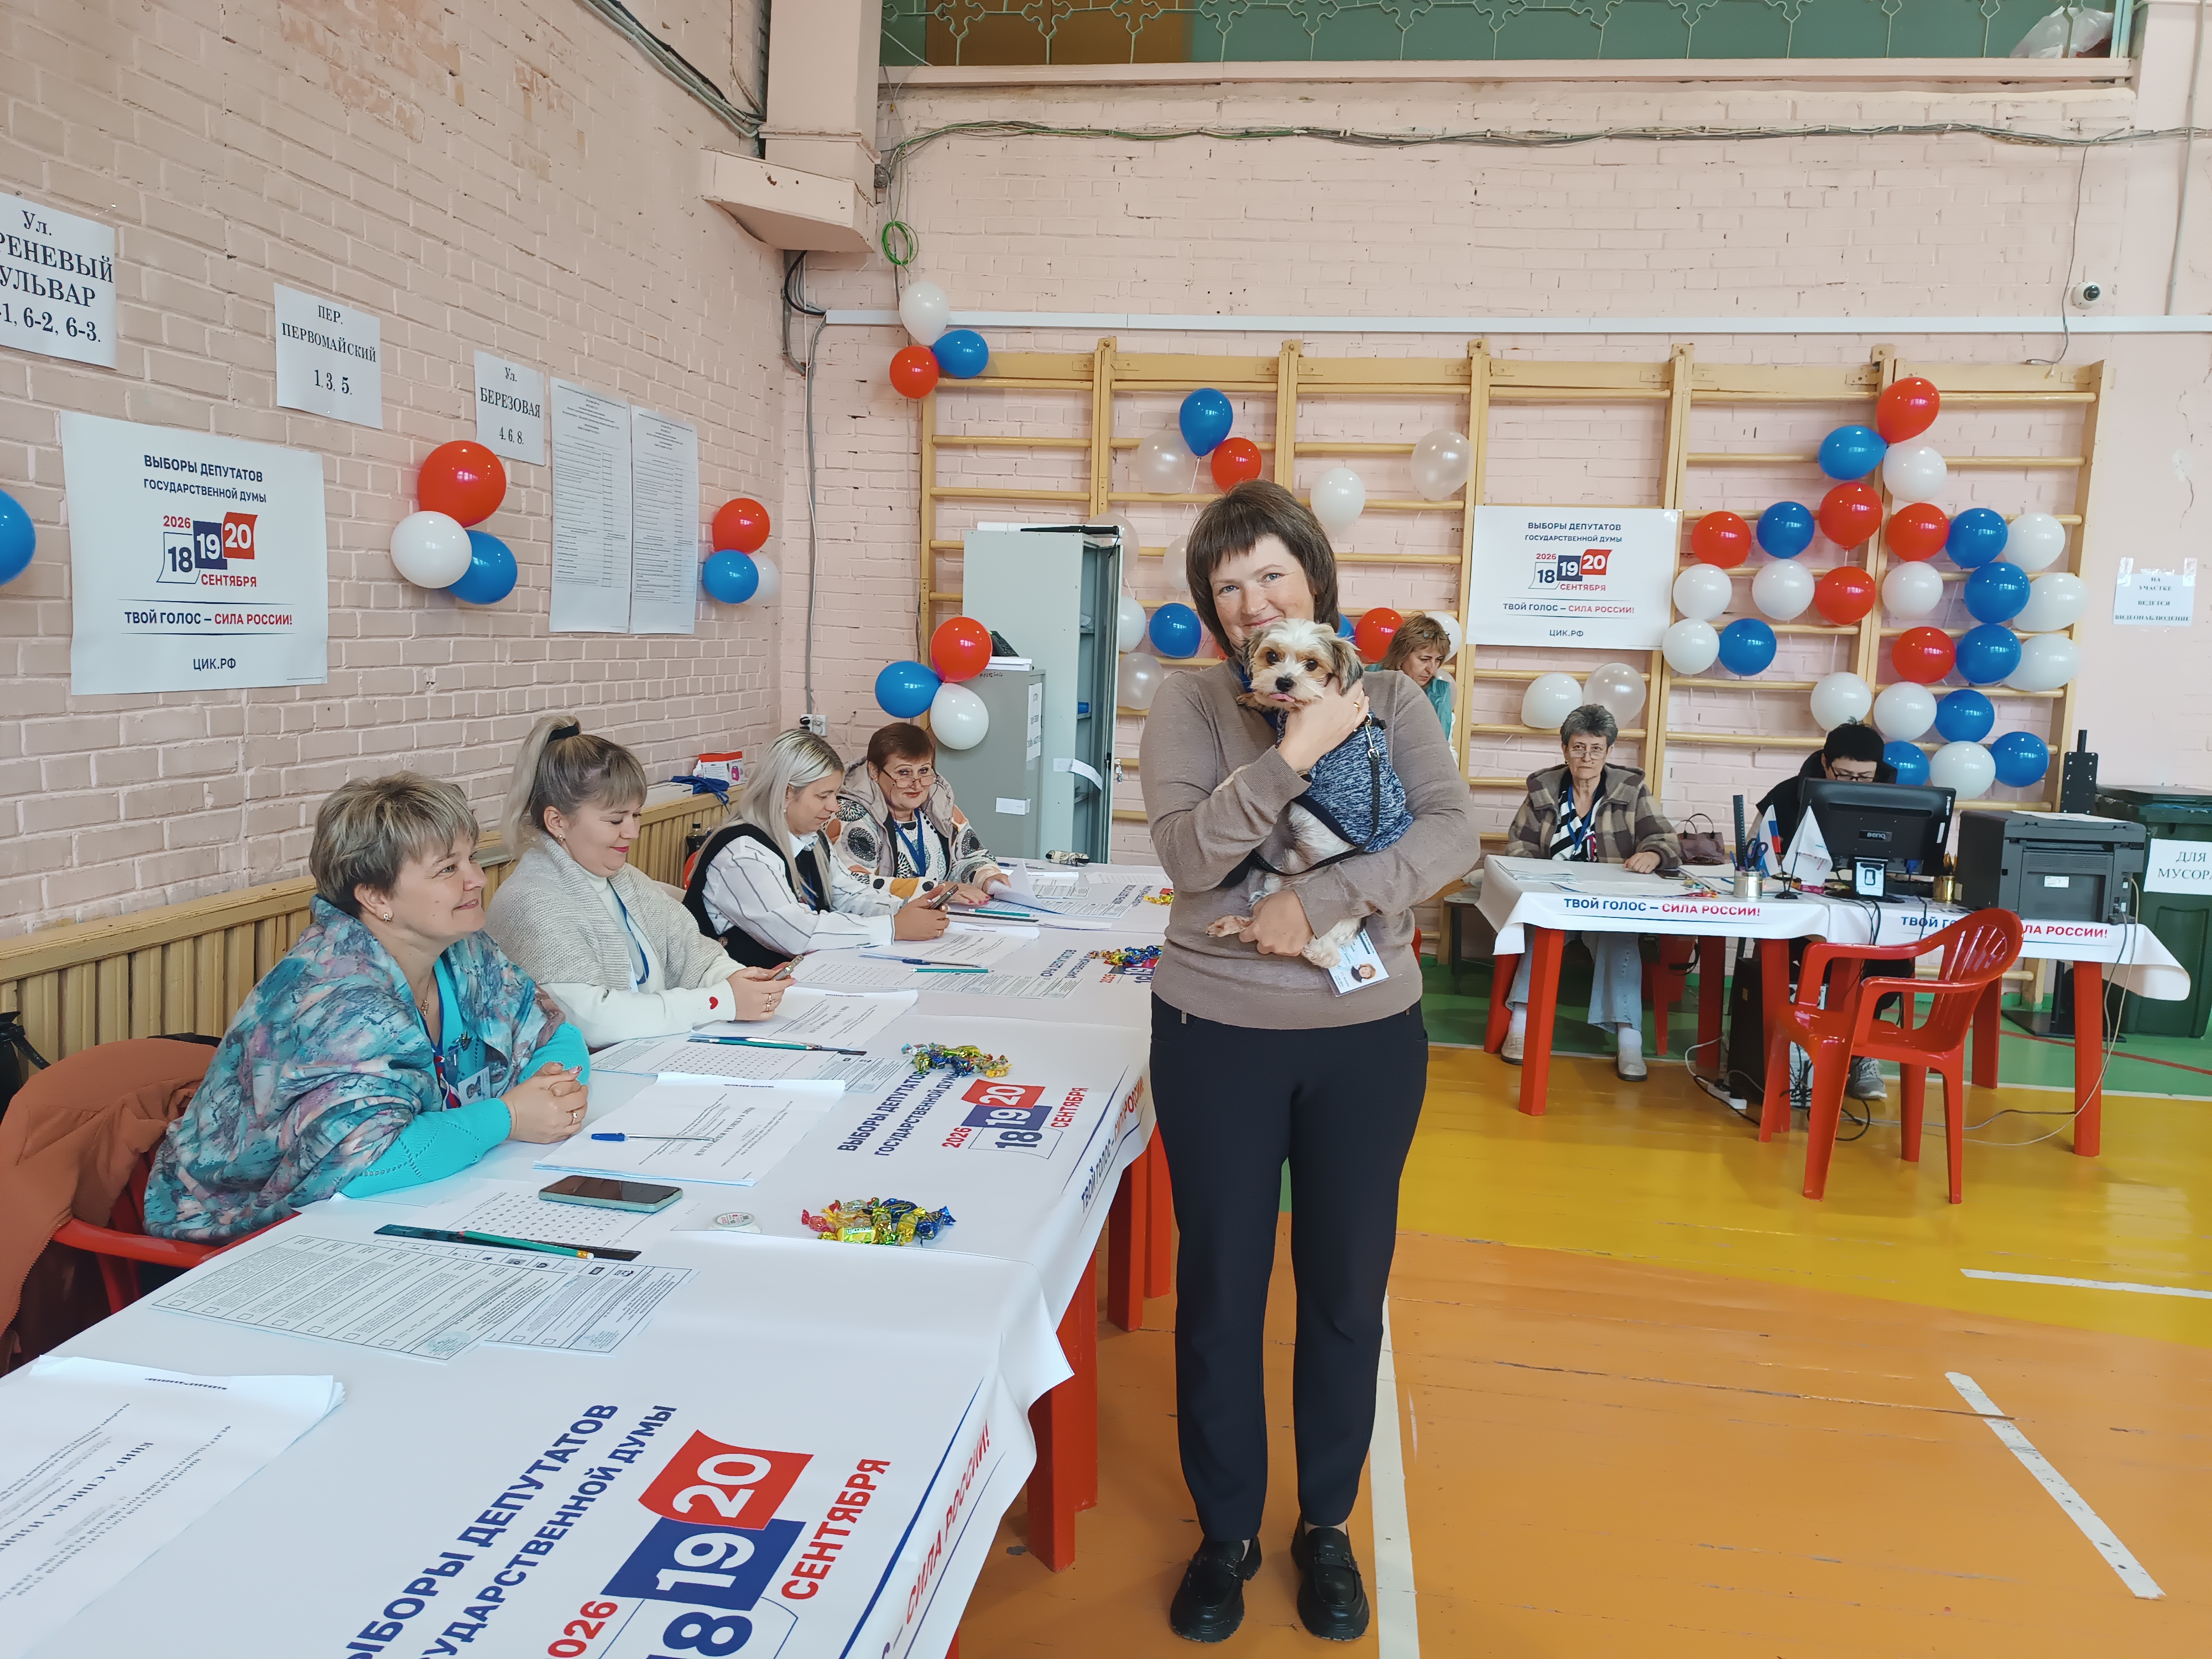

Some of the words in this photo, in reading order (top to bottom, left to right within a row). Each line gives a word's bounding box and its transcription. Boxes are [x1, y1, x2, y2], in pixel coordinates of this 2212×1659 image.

[22, 210, 52, 236] Ул.
[23, 307, 59, 336] 6-2,
[66, 317, 101, 342] 6-3.
[317, 305, 343, 325] ПЕР.
[281, 322, 377, 362] ПЕРВОМАЙСКИЙ
[504, 367, 517, 382] Ул.
[479, 387, 540, 418] БЕРЕЗОВАЯ
[144, 455, 197, 474] ВЫБОРЫ
[200, 463, 263, 482] ДЕПУТАТОВ
[143, 478, 238, 500] ГОСУДАРСТВЕННОЙ
[239, 491, 267, 503] ДУМЫ
[163, 515, 191, 529] 2026
[1528, 522, 1567, 530] ВЫБОРЫ
[1569, 523, 1621, 531] ДЕПУТАТОВ
[168, 546, 193, 573] 18
[196, 534, 221, 560] 19
[225, 522, 252, 549] 20
[1525, 534, 1598, 542] ГОСУДАРСТВЕННОЙ
[201, 573, 257, 587] СЕНТЯБРЯ
[1537, 569, 1555, 583] 18
[1559, 561, 1578, 576] 19
[1582, 555, 1606, 570] 20
[124, 609, 157, 624] ТВОЙ
[160, 612, 201, 625] ГОЛОС
[215, 613, 244, 625] СИЛА
[247, 614, 293, 625] РОССИИ!
[1503, 602, 1526, 611] ТВОЙ
[1550, 629, 1584, 638] ЦИК.РФ
[193, 658, 236, 671] ЦИК.РФ
[2176, 852, 2207, 863] ДЛЯ
[2157, 868, 2212, 880] МУСОР
[1563, 898, 1599, 910] ТВОЙ
[1603, 900, 1646, 911] ГОЛОС
[1662, 903, 1698, 914] СИЛА
[1702, 905, 1760, 916] РОССИИ!
[1901, 916, 1938, 928] ТВОЙ
[2046, 926, 2107, 938] РОССИИ!
[979, 1086, 1026, 1105] 20
[1051, 1087, 1089, 1128] СЕНТЯБРЯ
[837, 1113, 889, 1151] ВЫБОРЫ
[876, 1071, 930, 1113] ДЕПУТАТОВ
[874, 1089, 946, 1156] ГОСУДАРСТВЕННОЙ
[985, 1109, 1031, 1126] 19
[941, 1127, 972, 1148] 2026
[994, 1131, 1042, 1149] 18
[1081, 1166, 1095, 1213] ТВОЙ
[1095, 1138, 1111, 1185] ГОЛОС
[607, 1405, 677, 1463] ДУМЫ
[104, 1442, 154, 1472] КНИГА
[140, 1466, 179, 1495] СОБРАНИЯ
[456, 1405, 618, 1547] ДЕПУТАТОВ
[672, 1453, 771, 1518] 20
[42, 1476, 106, 1518] СПИСКА
[86, 1496, 141, 1534] РОССИЙСКОЙ
[906, 1529, 942, 1625] СИЛА
[945, 1418, 989, 1543] РОССИИ!
[781, 1459, 891, 1600] СЕНТЯБРЯ
[656, 1532, 755, 1591] 19
[546, 1600, 618, 1659] 026
